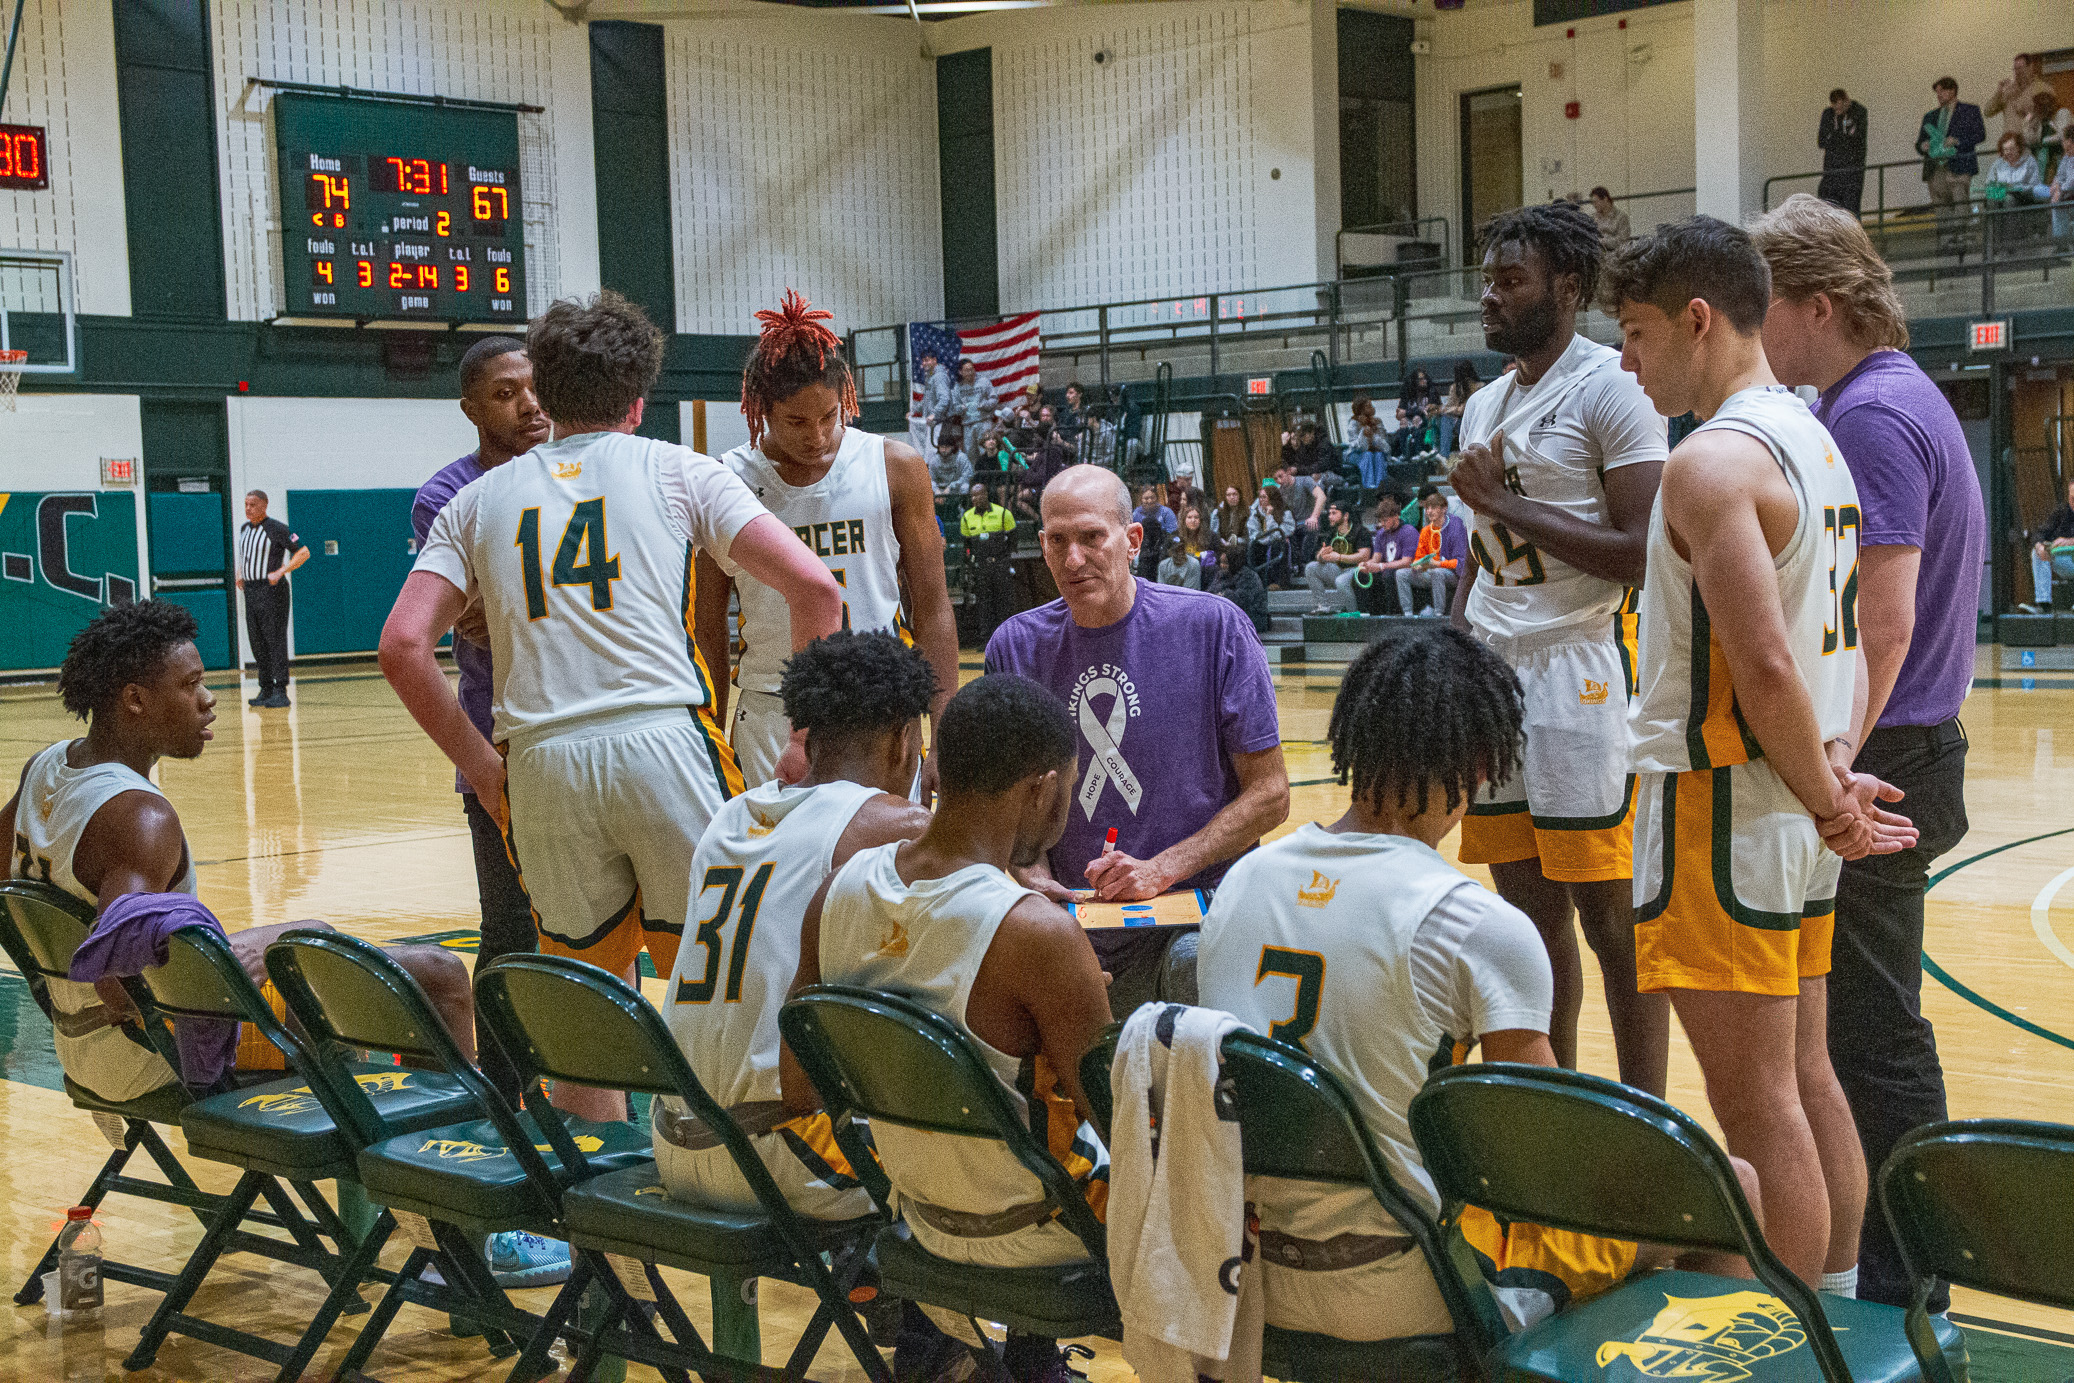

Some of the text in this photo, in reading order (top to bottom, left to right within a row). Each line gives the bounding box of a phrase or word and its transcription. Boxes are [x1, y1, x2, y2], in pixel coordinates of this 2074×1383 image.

[310, 153, 341, 172] Home
[387, 157, 448, 194] 7:31
[468, 166, 505, 184] Guests
[312, 174, 350, 210] 74
[473, 186, 508, 220] 67
[393, 210, 450, 237] period 2
[307, 237, 335, 255] fouls
[394, 241, 430, 261] player
[487, 247, 512, 263] fouls
[317, 261, 333, 285] 4
[358, 260, 372, 288] 3
[455, 265, 469, 292] 3
[495, 267, 510, 293] 6
[313, 292, 336, 305] won
[401, 296, 429, 310] game
[491, 299, 513, 311] won
[1976, 325, 2000, 344] EXIT
[111, 461, 131, 478] EXIT
[514, 495, 622, 622] 14
[1067, 663, 1141, 724] IKINGS STRONG
[1085, 773, 1101, 800] HOPE
[1106, 757, 1137, 796] COURAGE
[675, 861, 777, 1005] 31
